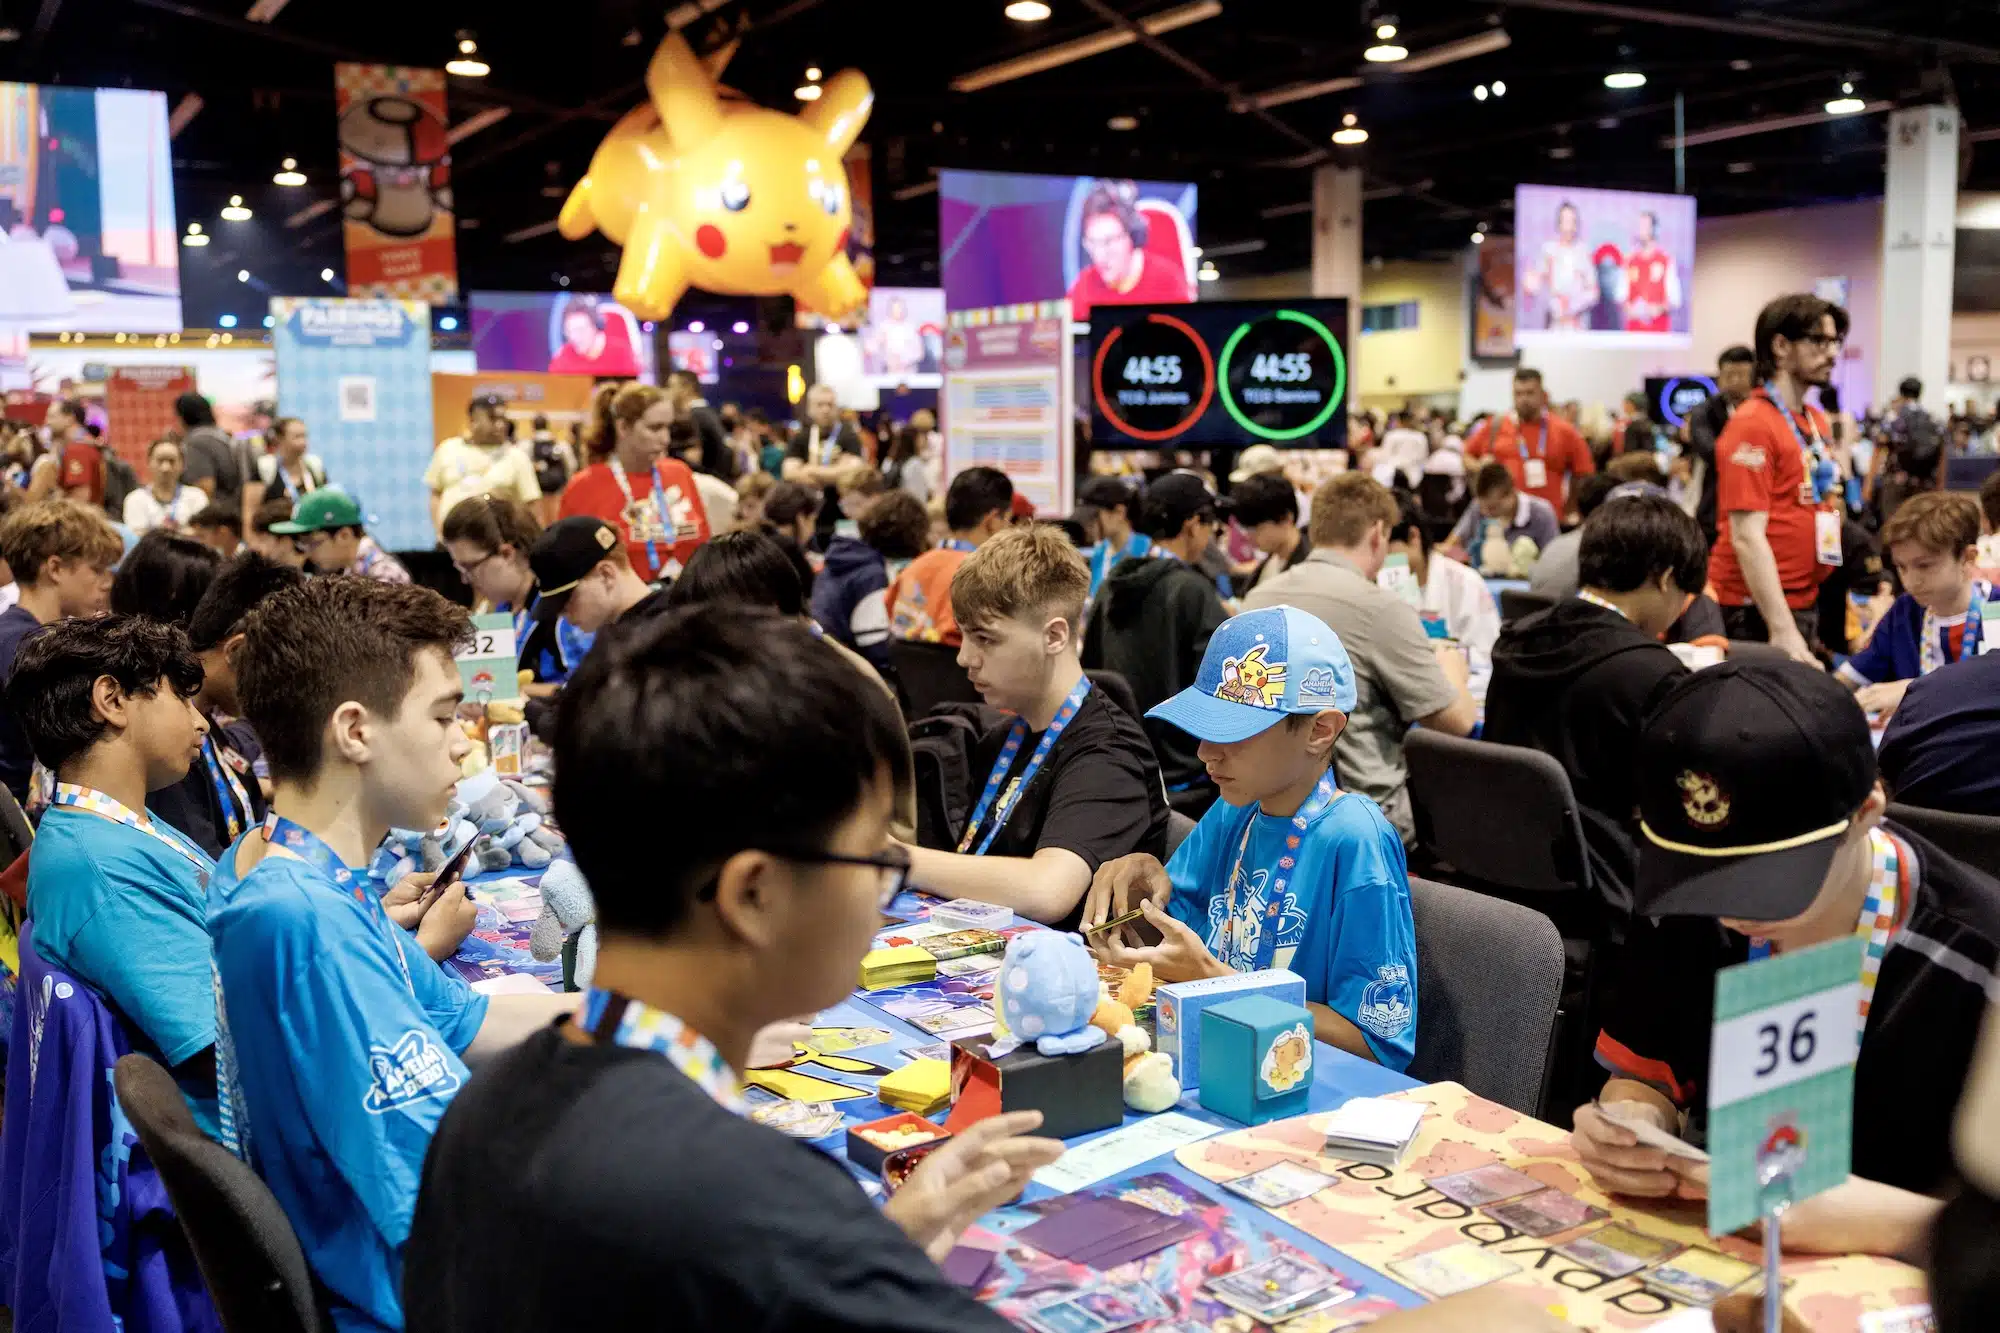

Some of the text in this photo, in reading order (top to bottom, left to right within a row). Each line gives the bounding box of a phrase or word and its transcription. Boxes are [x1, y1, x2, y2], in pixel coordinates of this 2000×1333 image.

[1122, 355, 1183, 385] 44:55
[1250, 353, 1313, 383] 44:55
[467, 636, 495, 655] 32
[1362, 1005, 1410, 1023] WORLD
[1755, 1010, 1817, 1078] 36
